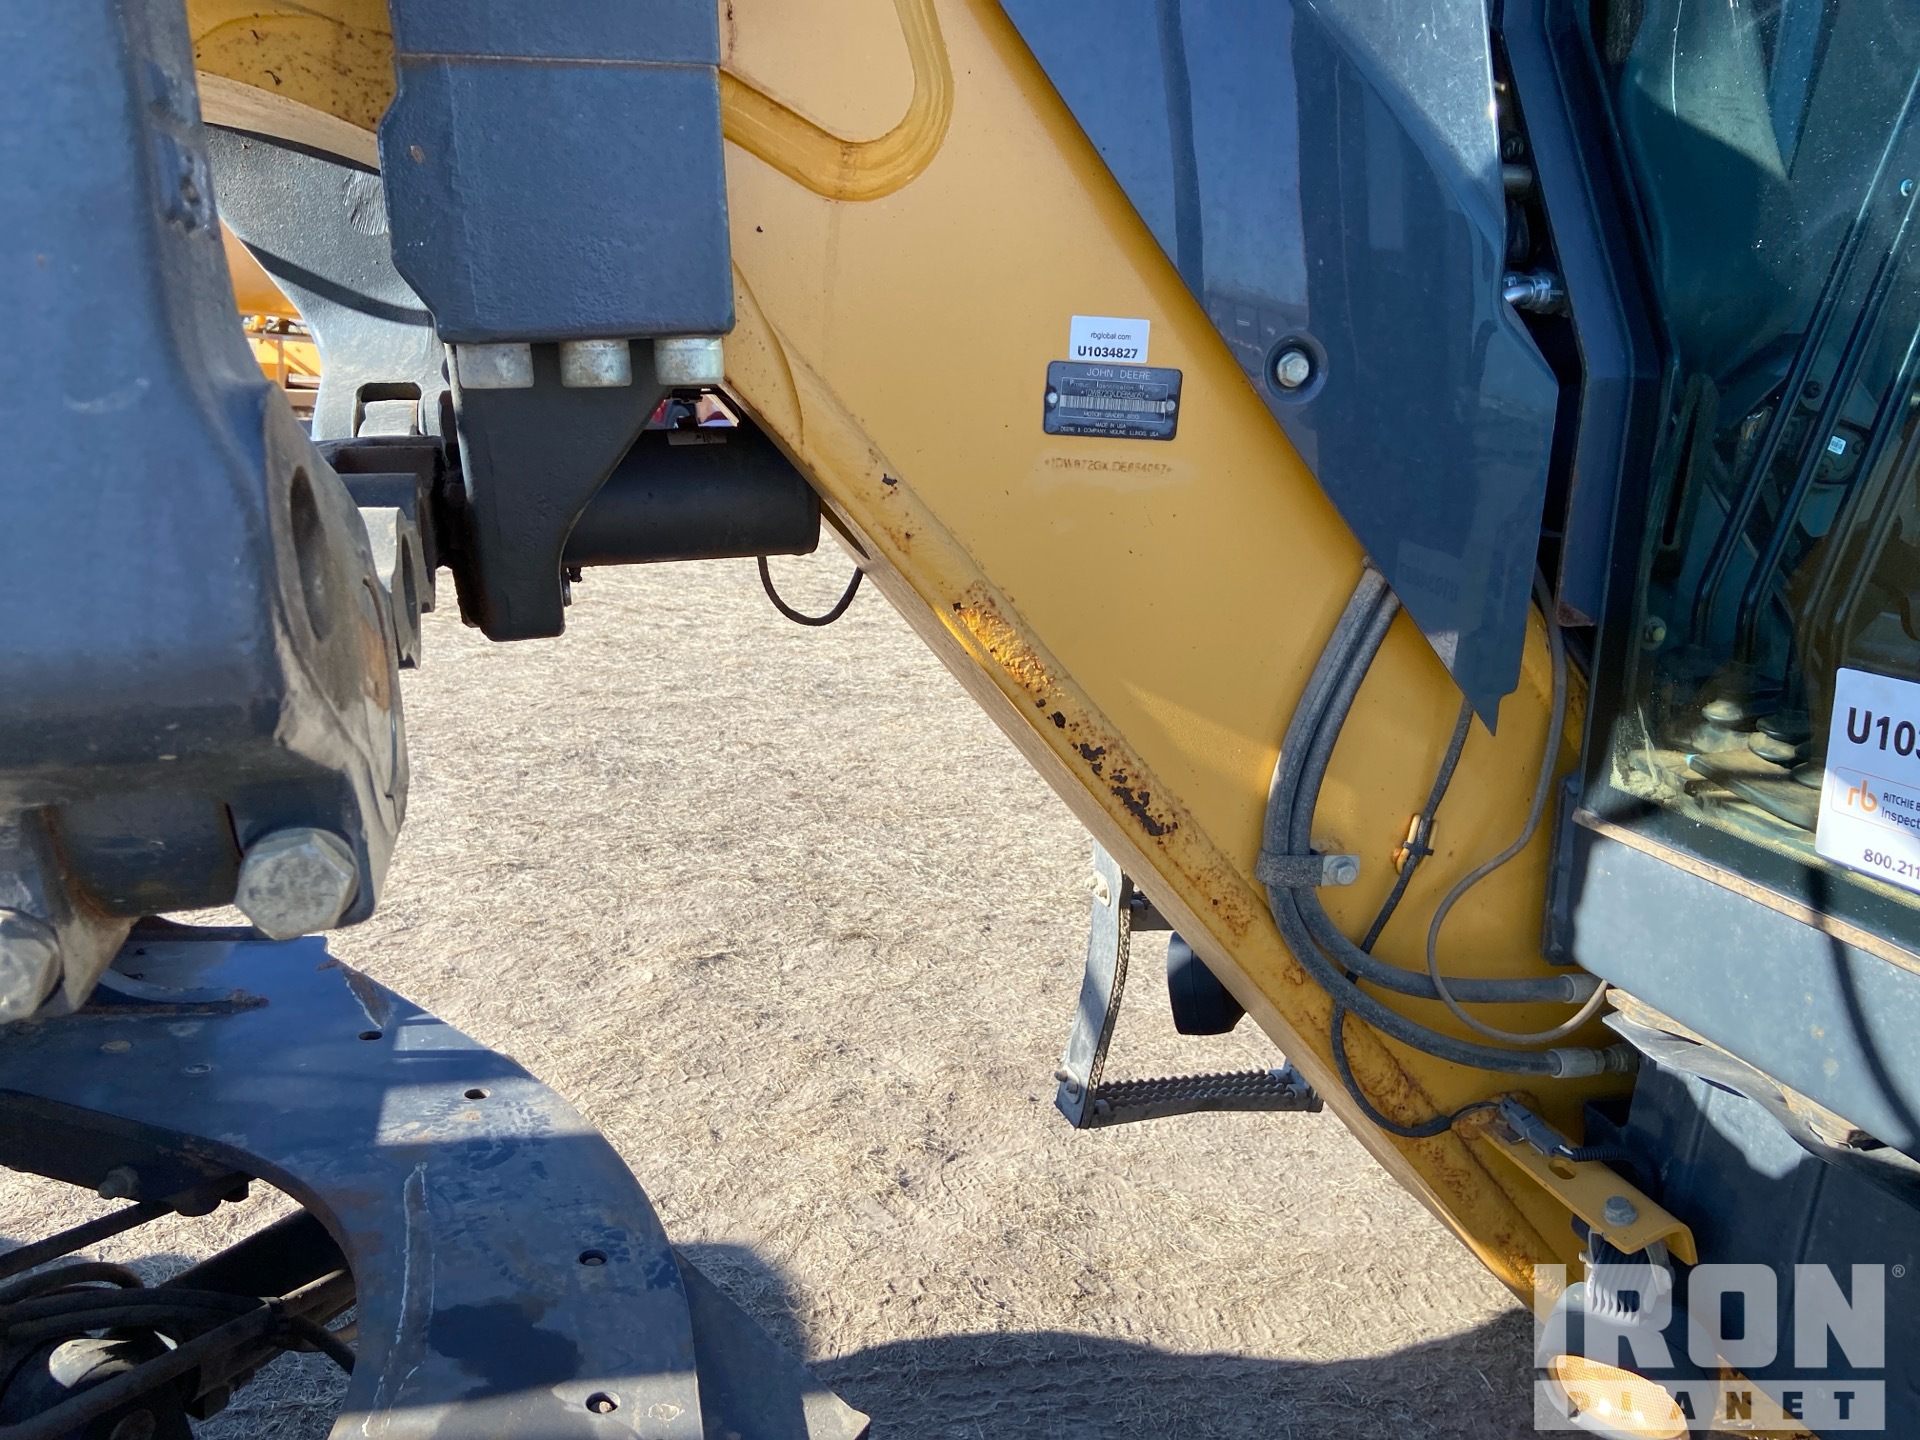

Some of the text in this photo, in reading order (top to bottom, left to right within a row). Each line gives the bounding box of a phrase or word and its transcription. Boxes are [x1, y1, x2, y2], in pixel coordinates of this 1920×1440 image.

[1090, 332, 1131, 341] rbglobal.com
[1077, 345, 1138, 359] U1034827
[1086, 367, 1151, 380] JOHN DEERE
[1847, 780, 1878, 812] rb
[1883, 792, 1914, 810] RITCHIE
